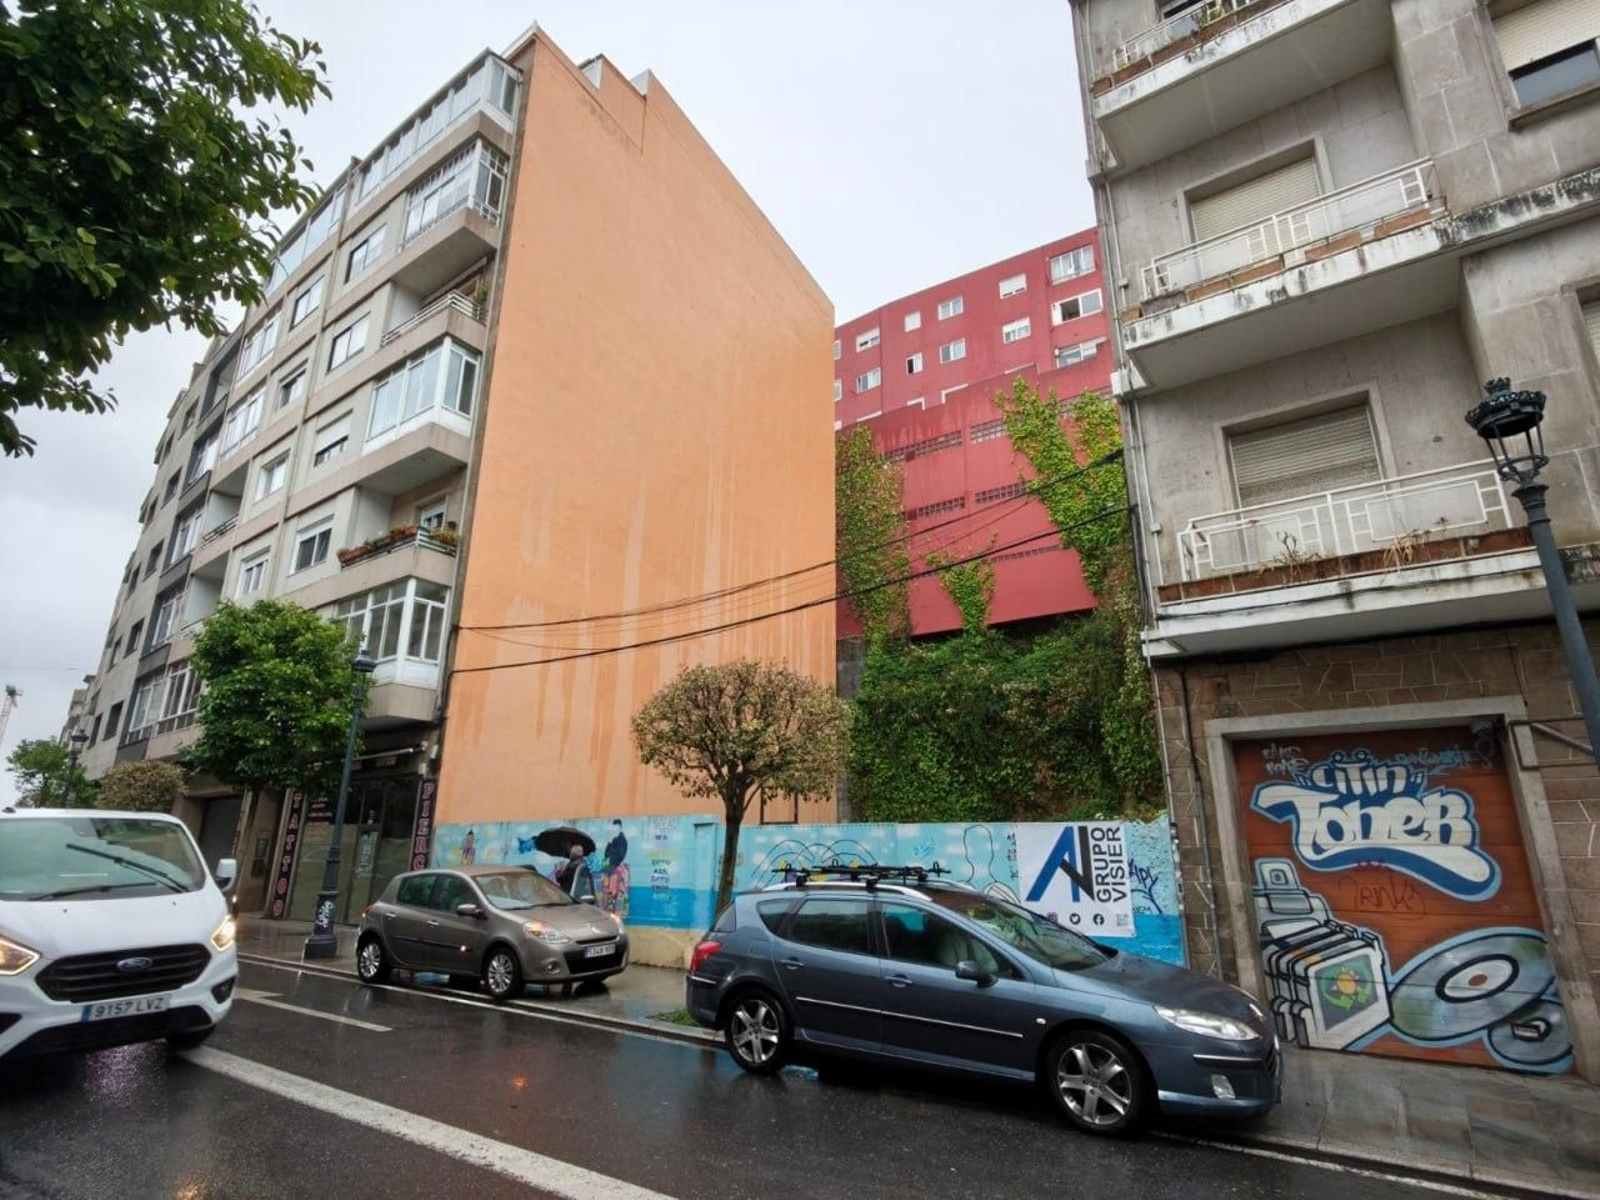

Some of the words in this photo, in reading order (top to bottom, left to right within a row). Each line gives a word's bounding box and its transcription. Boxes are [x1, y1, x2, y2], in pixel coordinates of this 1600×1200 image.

[273, 793, 302, 916] TATTOO
[1090, 827, 1112, 903] GRUPO
[1105, 826, 1127, 902] VISIER
[94, 1001, 133, 1019] 9157
[135, 997, 165, 1012] LVZ
